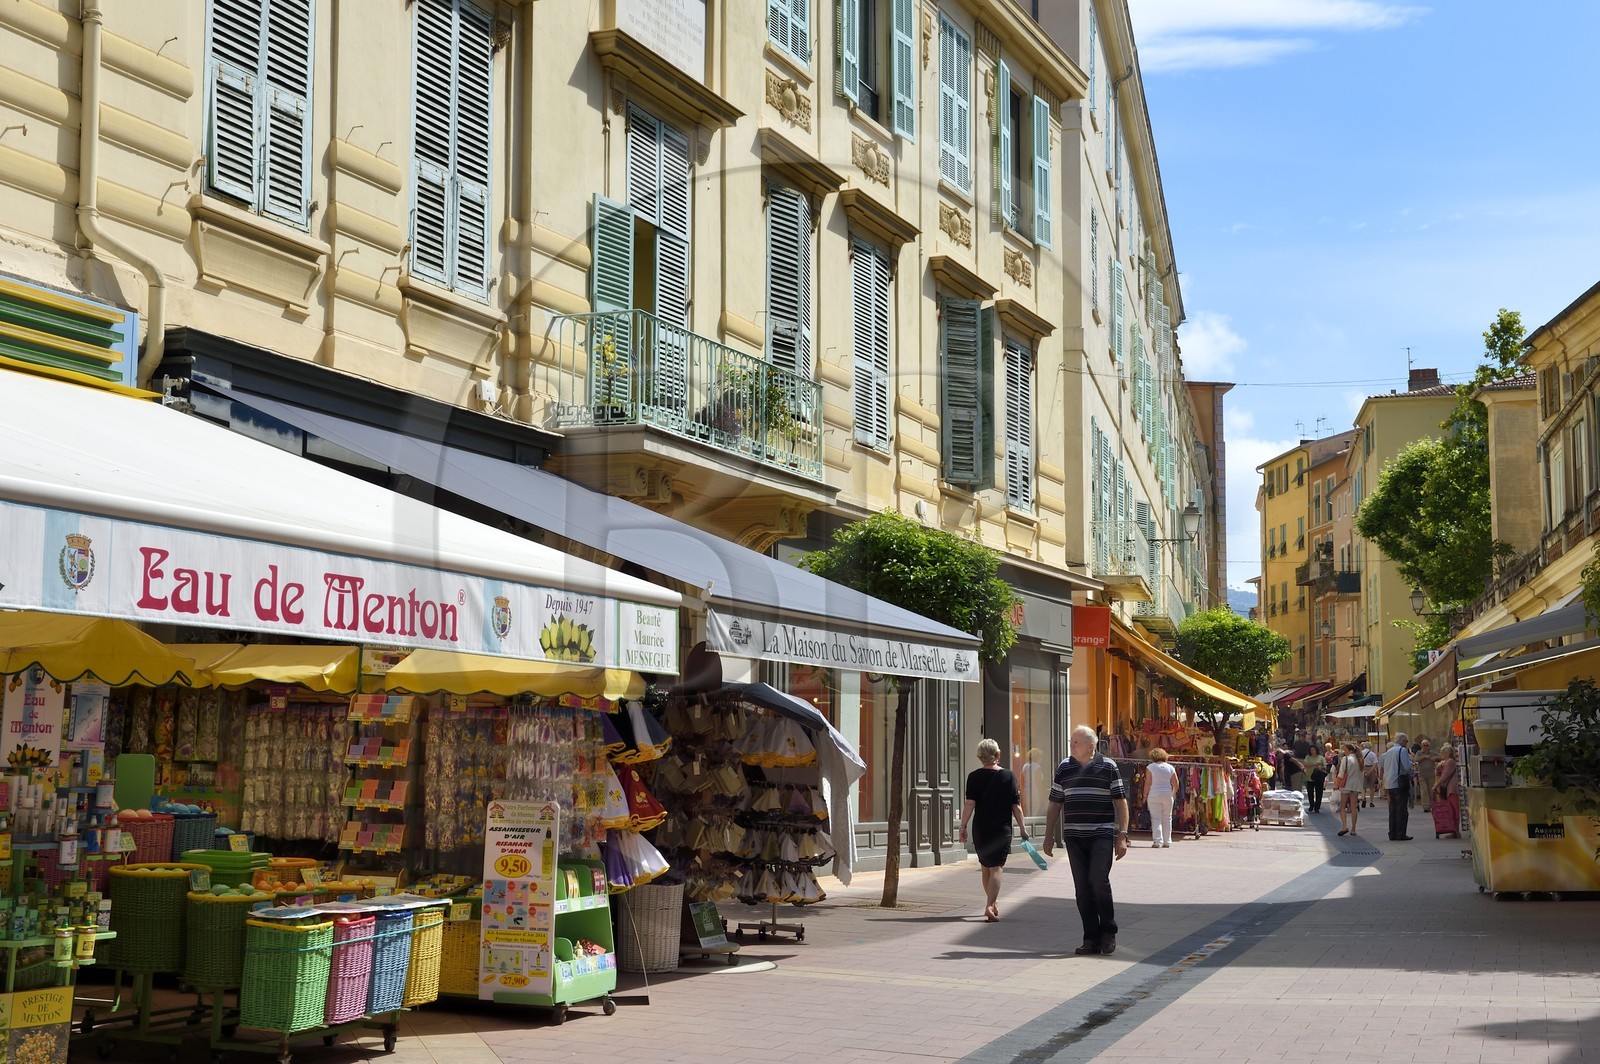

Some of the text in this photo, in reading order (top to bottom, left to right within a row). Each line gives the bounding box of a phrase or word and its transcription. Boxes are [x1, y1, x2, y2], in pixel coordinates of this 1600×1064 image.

[136, 546, 232, 617] Eau
[253, 564, 305, 624] de
[545, 593, 594, 616] Depuis 1947
[636, 609, 661, 628] Beauté
[633, 629, 665, 648] Maurice
[760, 622, 947, 674] La Maison du Savon de Marseille
[625, 649, 671, 668] MESSEGUE
[24, 693, 46, 706] Eau
[28, 709, 39, 719] de
[10, 720, 53, 734] Menton
[500, 859, 528, 875] 9,50
[22, 992, 64, 1009] PRESTIGE
[37, 1003, 49, 1013] DE
[22, 1009, 61, 1023] MENTON
